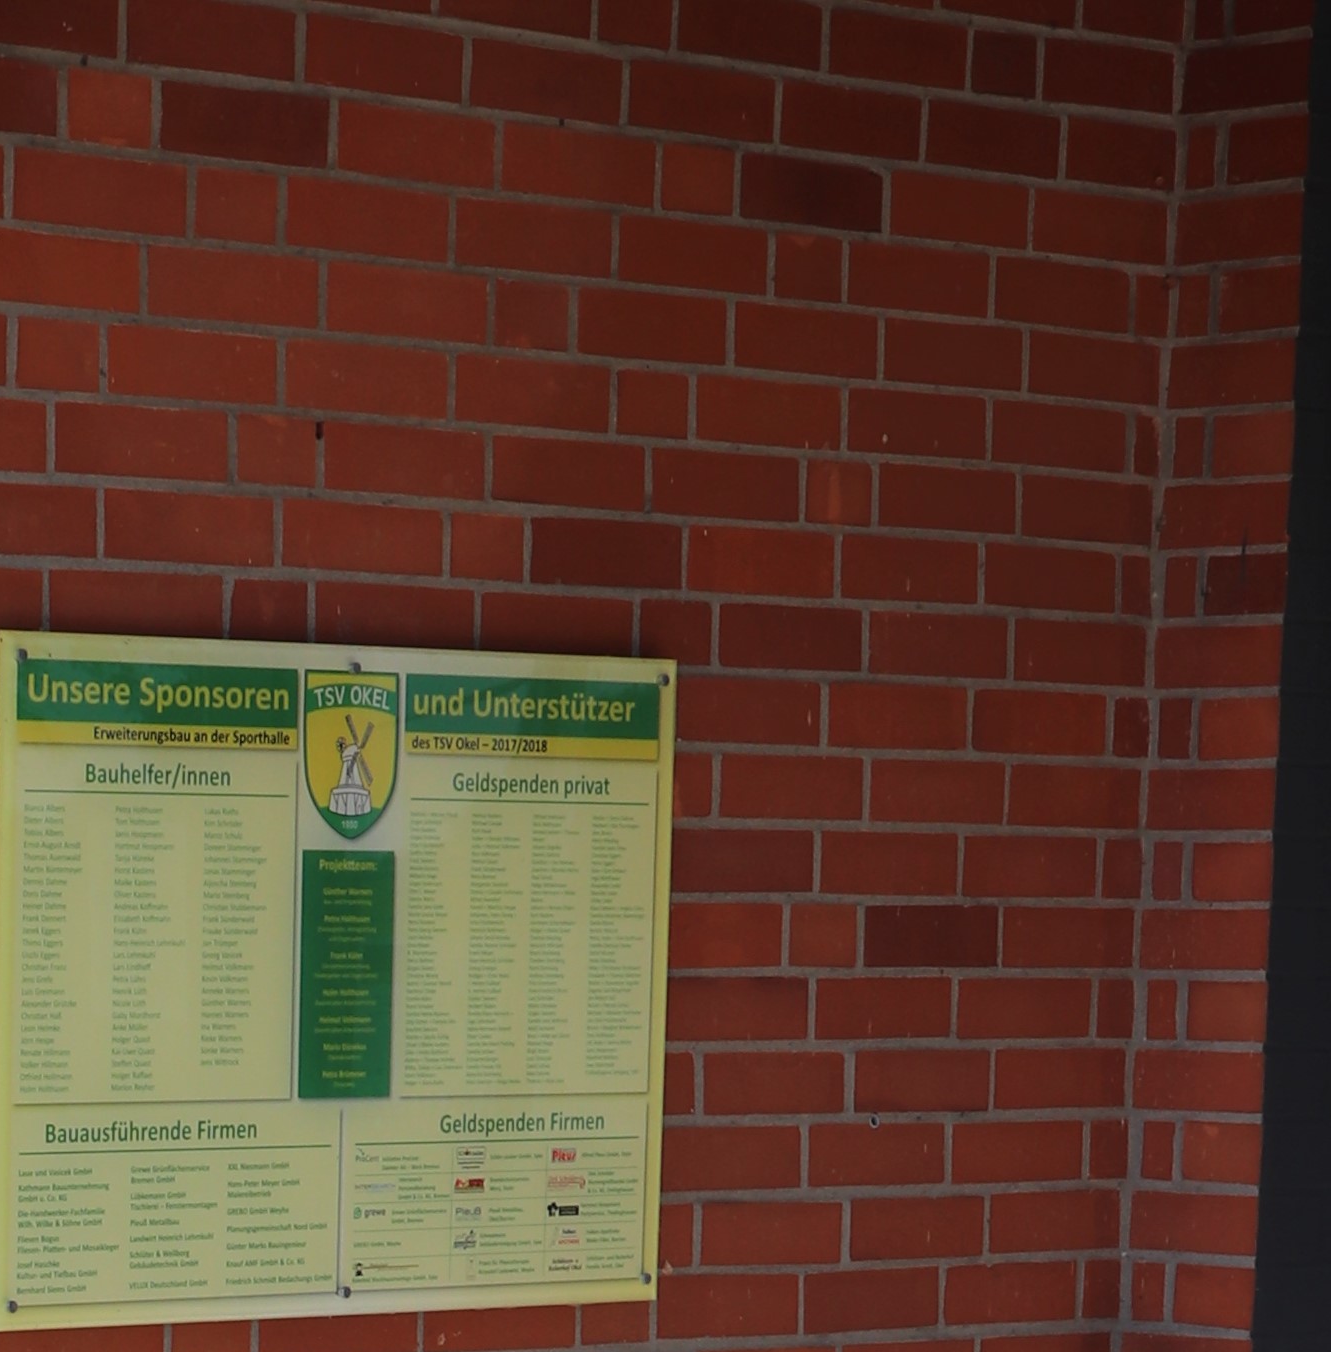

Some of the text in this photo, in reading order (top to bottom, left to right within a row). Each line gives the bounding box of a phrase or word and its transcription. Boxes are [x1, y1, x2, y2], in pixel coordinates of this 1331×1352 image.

[28, 673, 290, 713] Unsere Sponsoren
[314, 685, 390, 710] TSV OKEL
[413, 688, 636, 722] und Unterstützer
[93, 727, 290, 747] Erweiterungsbau an der Sporthalle
[411, 736, 430, 750] des
[433, 737, 453, 750] TSV
[456, 737, 480, 751] Okel
[492, 738, 548, 755] 2017/2018
[86, 763, 231, 788] Bauhelfer/innen
[453, 772, 611, 798] Geldspenden privat
[319, 859, 378, 873] Projektteam:
[45, 1120, 257, 1143] Bauausführende Firmen
[440, 1112, 605, 1136] Geldspenden Firmen
